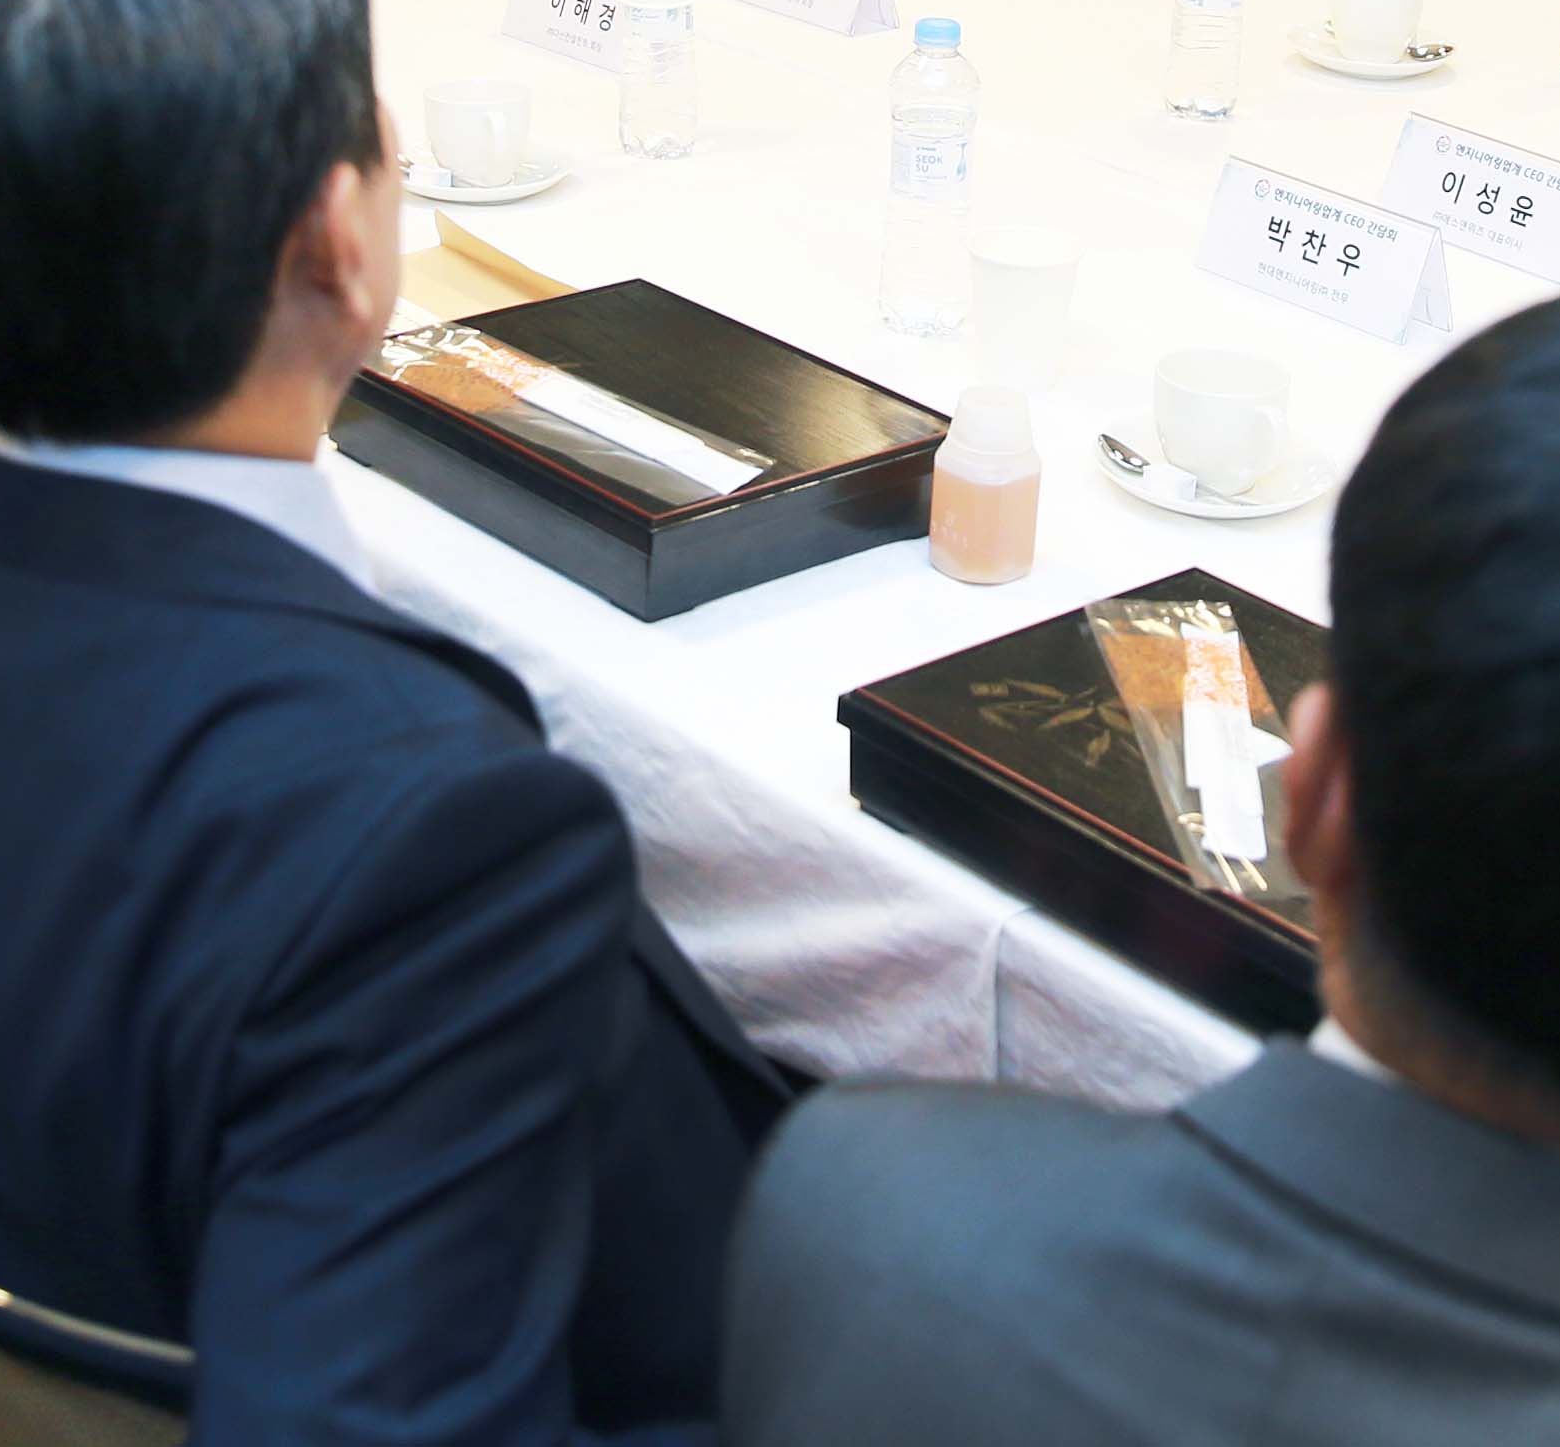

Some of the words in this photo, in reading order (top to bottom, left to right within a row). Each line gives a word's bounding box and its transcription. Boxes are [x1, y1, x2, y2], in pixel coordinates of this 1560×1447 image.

[1455, 142, 1523, 176] 엔지니어링업계
[1523, 166, 1545, 183] CEO
[1273, 186, 1343, 223] 엔지니어링업계
[1343, 212, 1366, 229] CEO
[1366, 219, 1399, 243] 간담회
